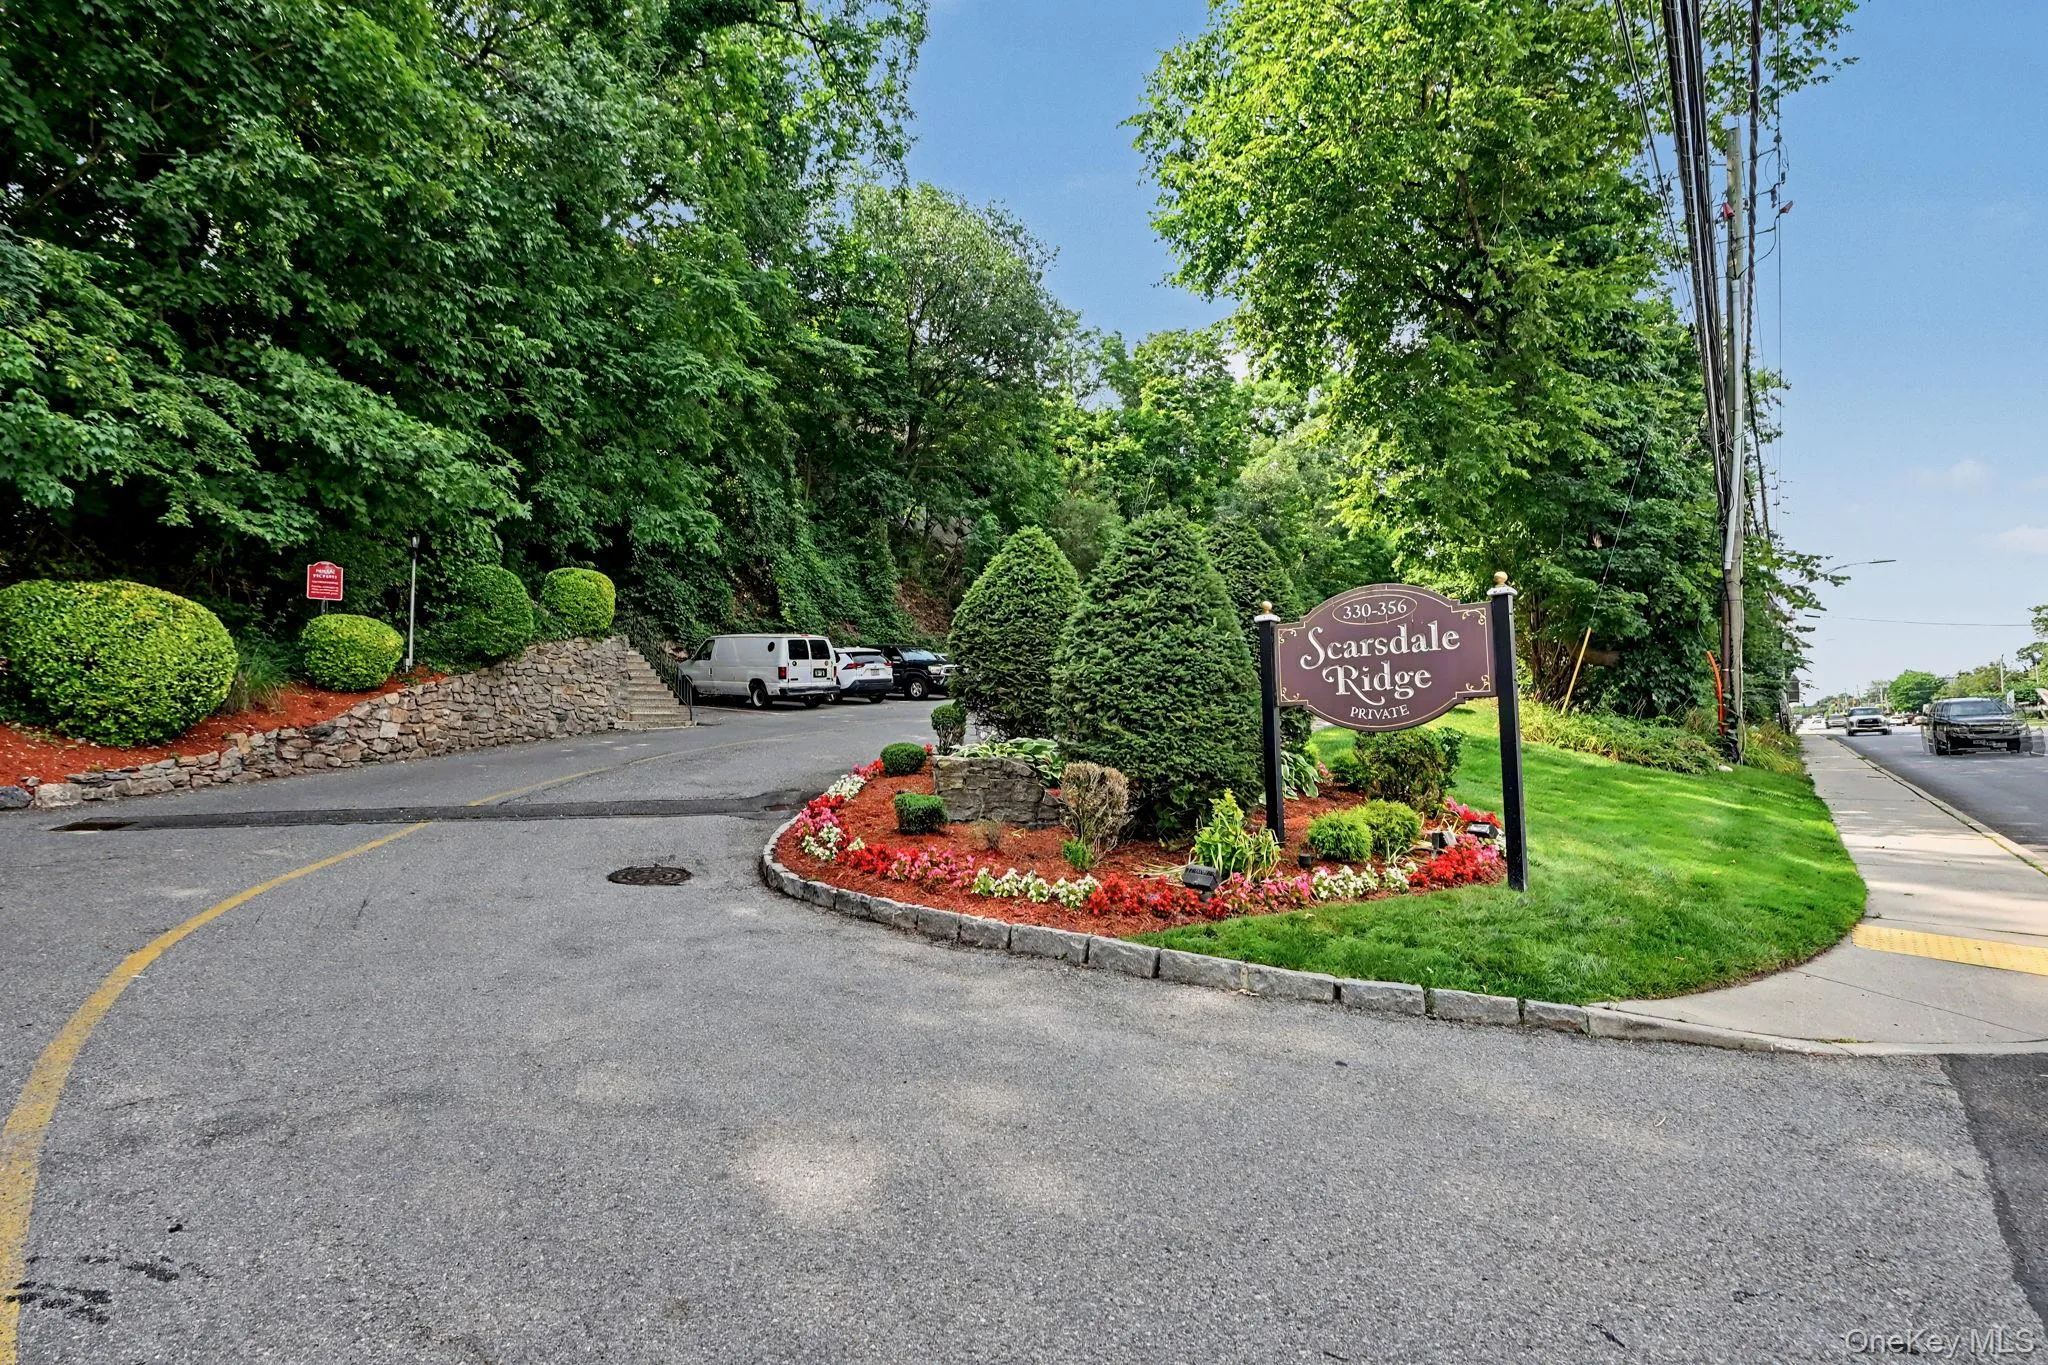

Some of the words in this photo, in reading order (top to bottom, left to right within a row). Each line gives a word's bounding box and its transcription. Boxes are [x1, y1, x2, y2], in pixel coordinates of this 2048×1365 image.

[1344, 600, 1407, 619] 330-356
[1300, 621, 1460, 669] Scarsdale
[1323, 660, 1432, 705] Ridge
[1350, 704, 1410, 720] PRIVATE
